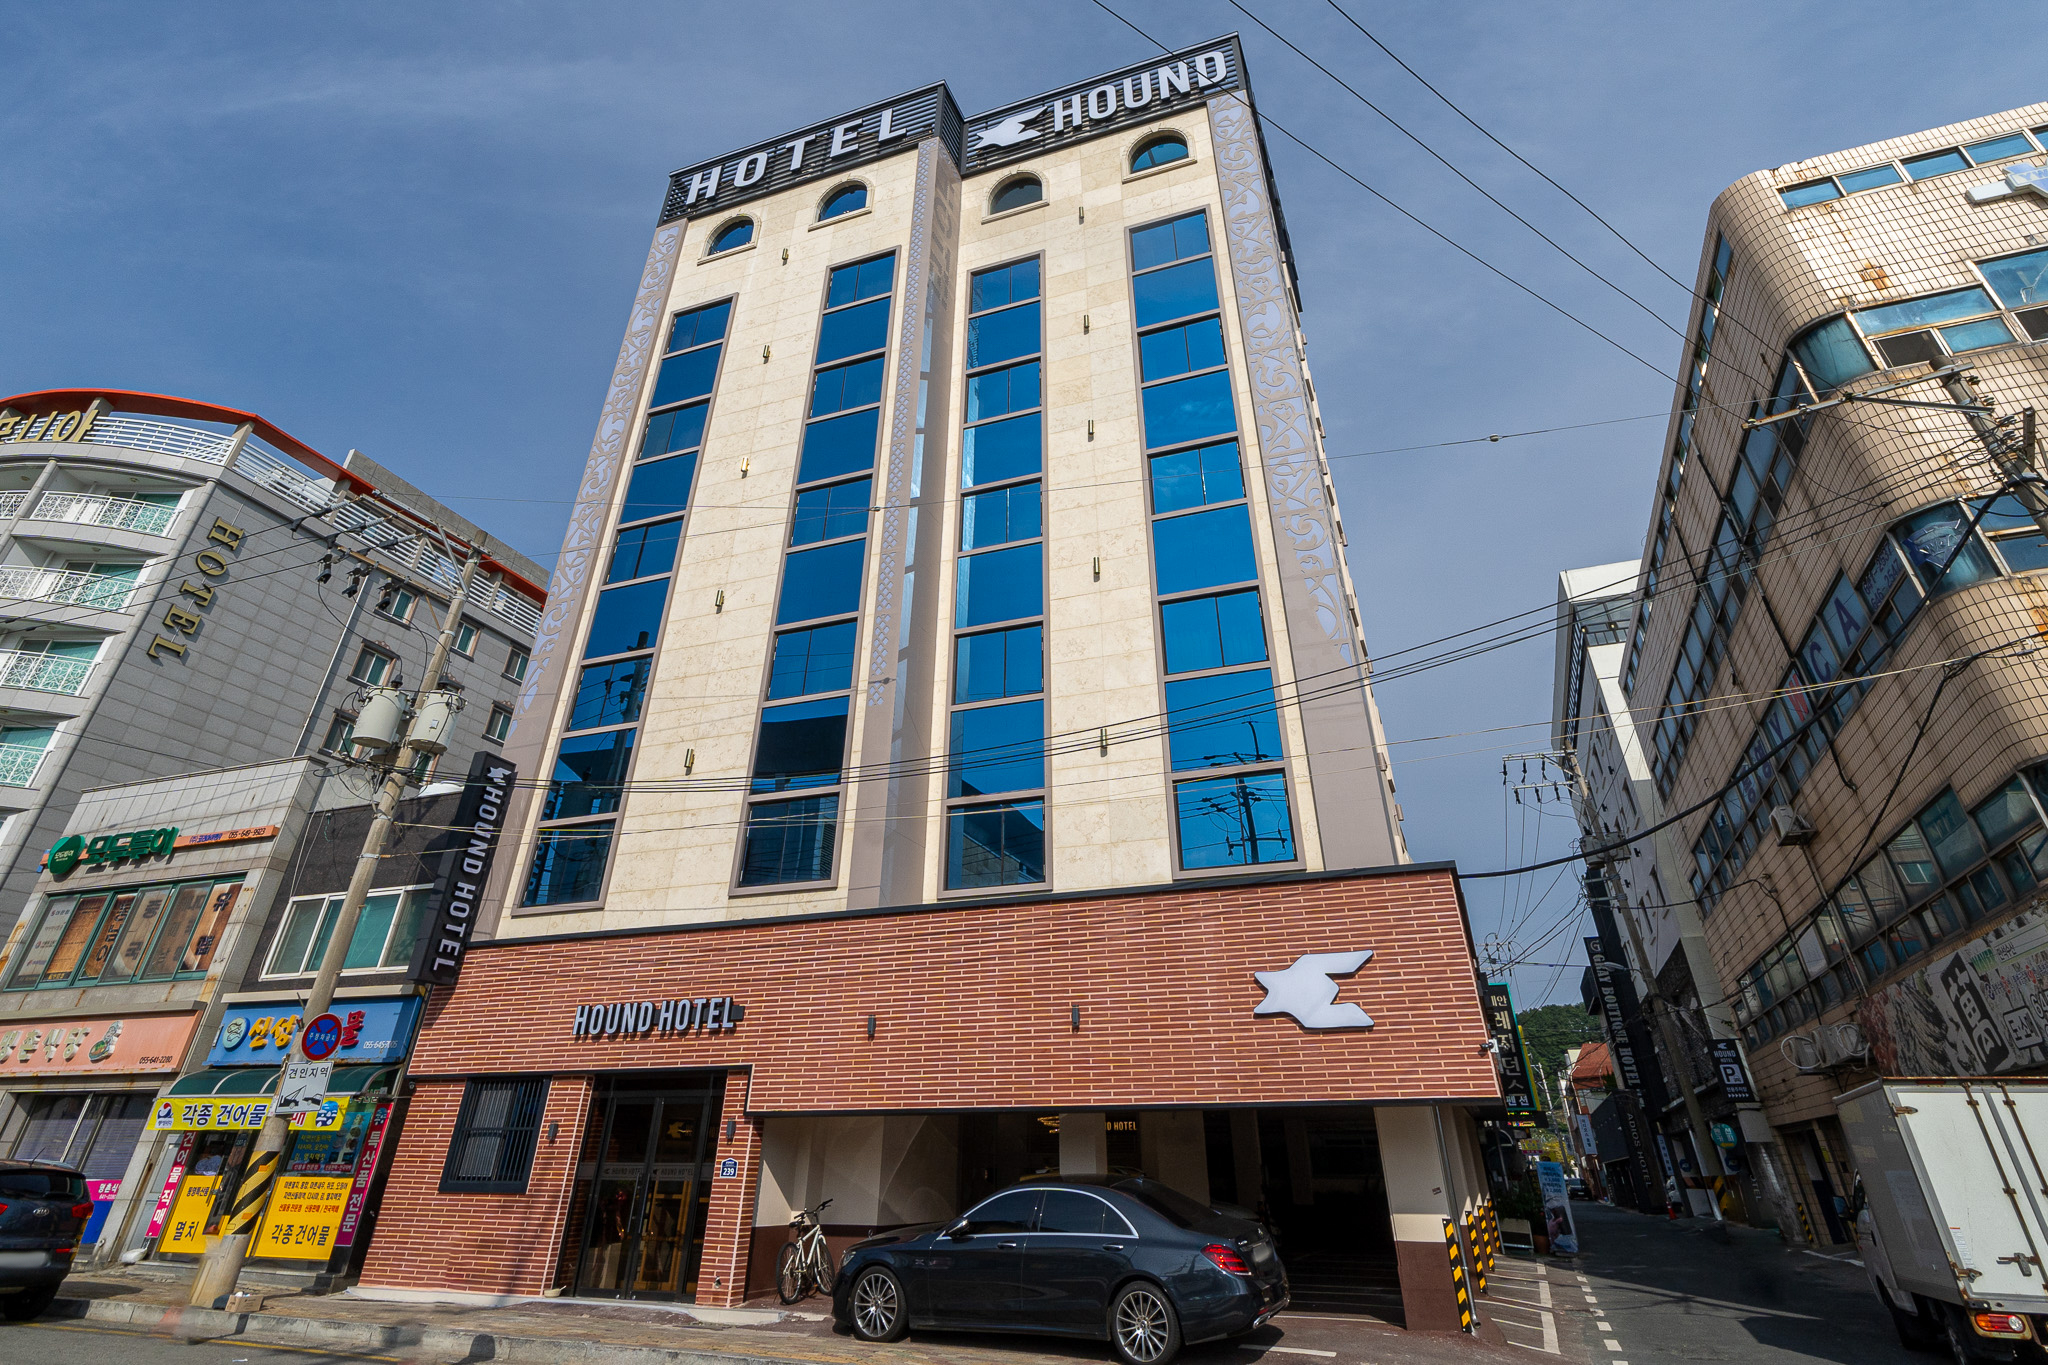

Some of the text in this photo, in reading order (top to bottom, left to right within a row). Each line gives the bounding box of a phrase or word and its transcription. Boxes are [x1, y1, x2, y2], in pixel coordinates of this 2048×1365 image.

[1054, 51, 1227, 132] HOUND
[686, 108, 909, 205] HOTEL
[147, 517, 245, 659] HOTEL
[1768, 597, 1861, 748] YWCA
[82, 826, 178, 865] 모두투어
[433, 786, 504, 971] HOUND HOTEL
[249, 1014, 299, 1048] 신성
[572, 997, 734, 1035] HOUND HOTEL
[139, 1056, 173, 1064] 055-641-2280
[288, 1067, 329, 1079] 견인지역
[1619, 1047, 1641, 1087] HOTEL
[1713, 1050, 1736, 1058] HOUND
[181, 1103, 213, 1126] 각종
[216, 1103, 268, 1126] 건어물
[1506, 1094, 1530, 1107] 펜션
[1113, 1122, 1137, 1130] HOTEL
[168, 1131, 196, 1183] 건어물
[355, 1131, 382, 1188] 특산품
[1627, 1113, 1652, 1187] ADIOS HOTEL
[722, 1167, 735, 1176] 239
[173, 1220, 199, 1241] 멸치
[342, 1193, 362, 1232] 전문
[271, 1224, 331, 1246] 각종 건어물
